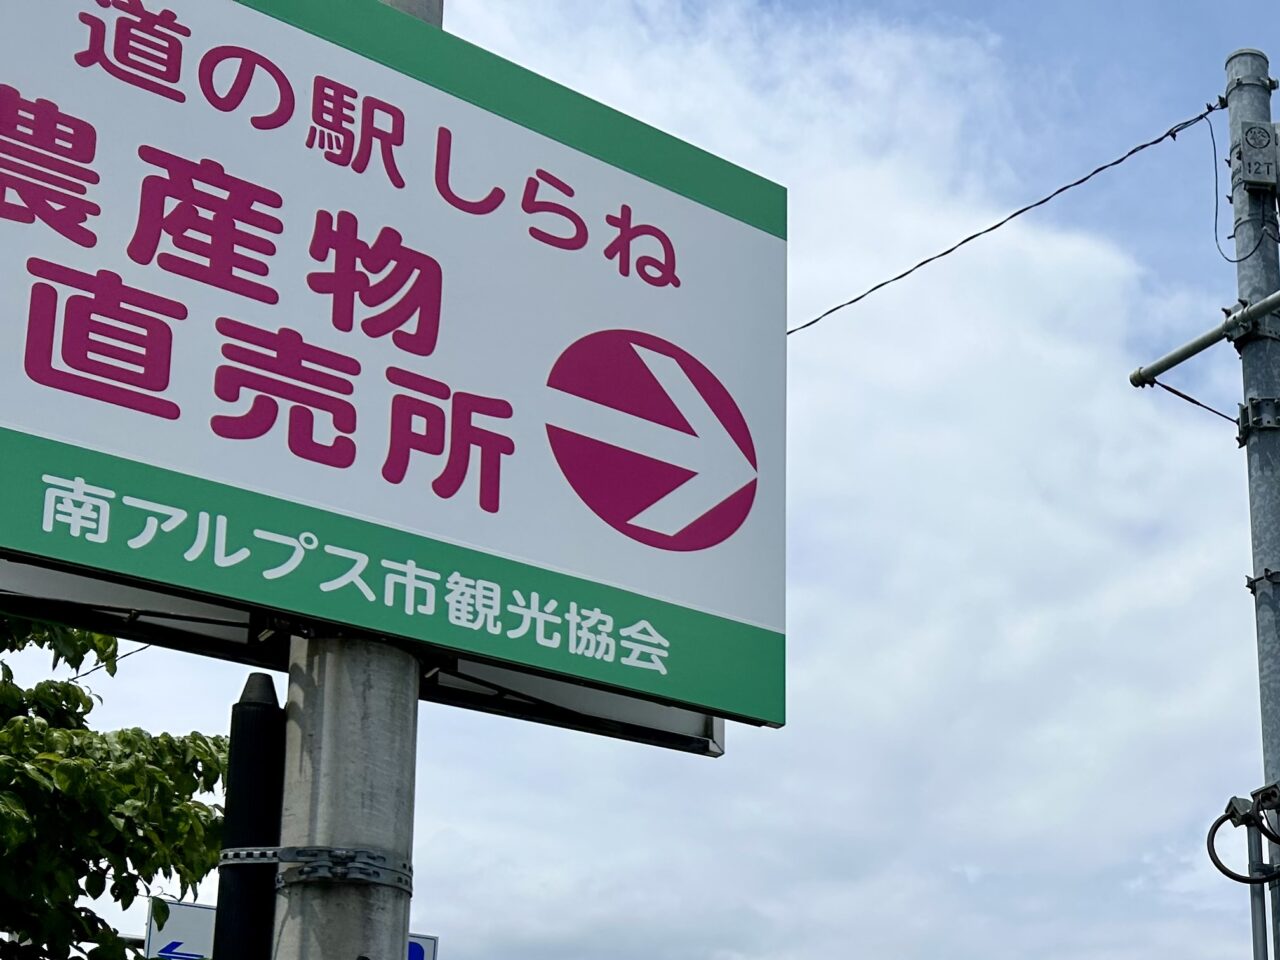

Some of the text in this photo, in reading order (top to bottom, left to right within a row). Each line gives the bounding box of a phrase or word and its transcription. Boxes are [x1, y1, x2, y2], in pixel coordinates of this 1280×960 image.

[0, 84, 443, 357] 農産物
[74, 0, 682, 289] 道の駅しらね
[24, 257, 516, 514] 直売所
[41, 474, 671, 676] 南アルプス市観光協会
